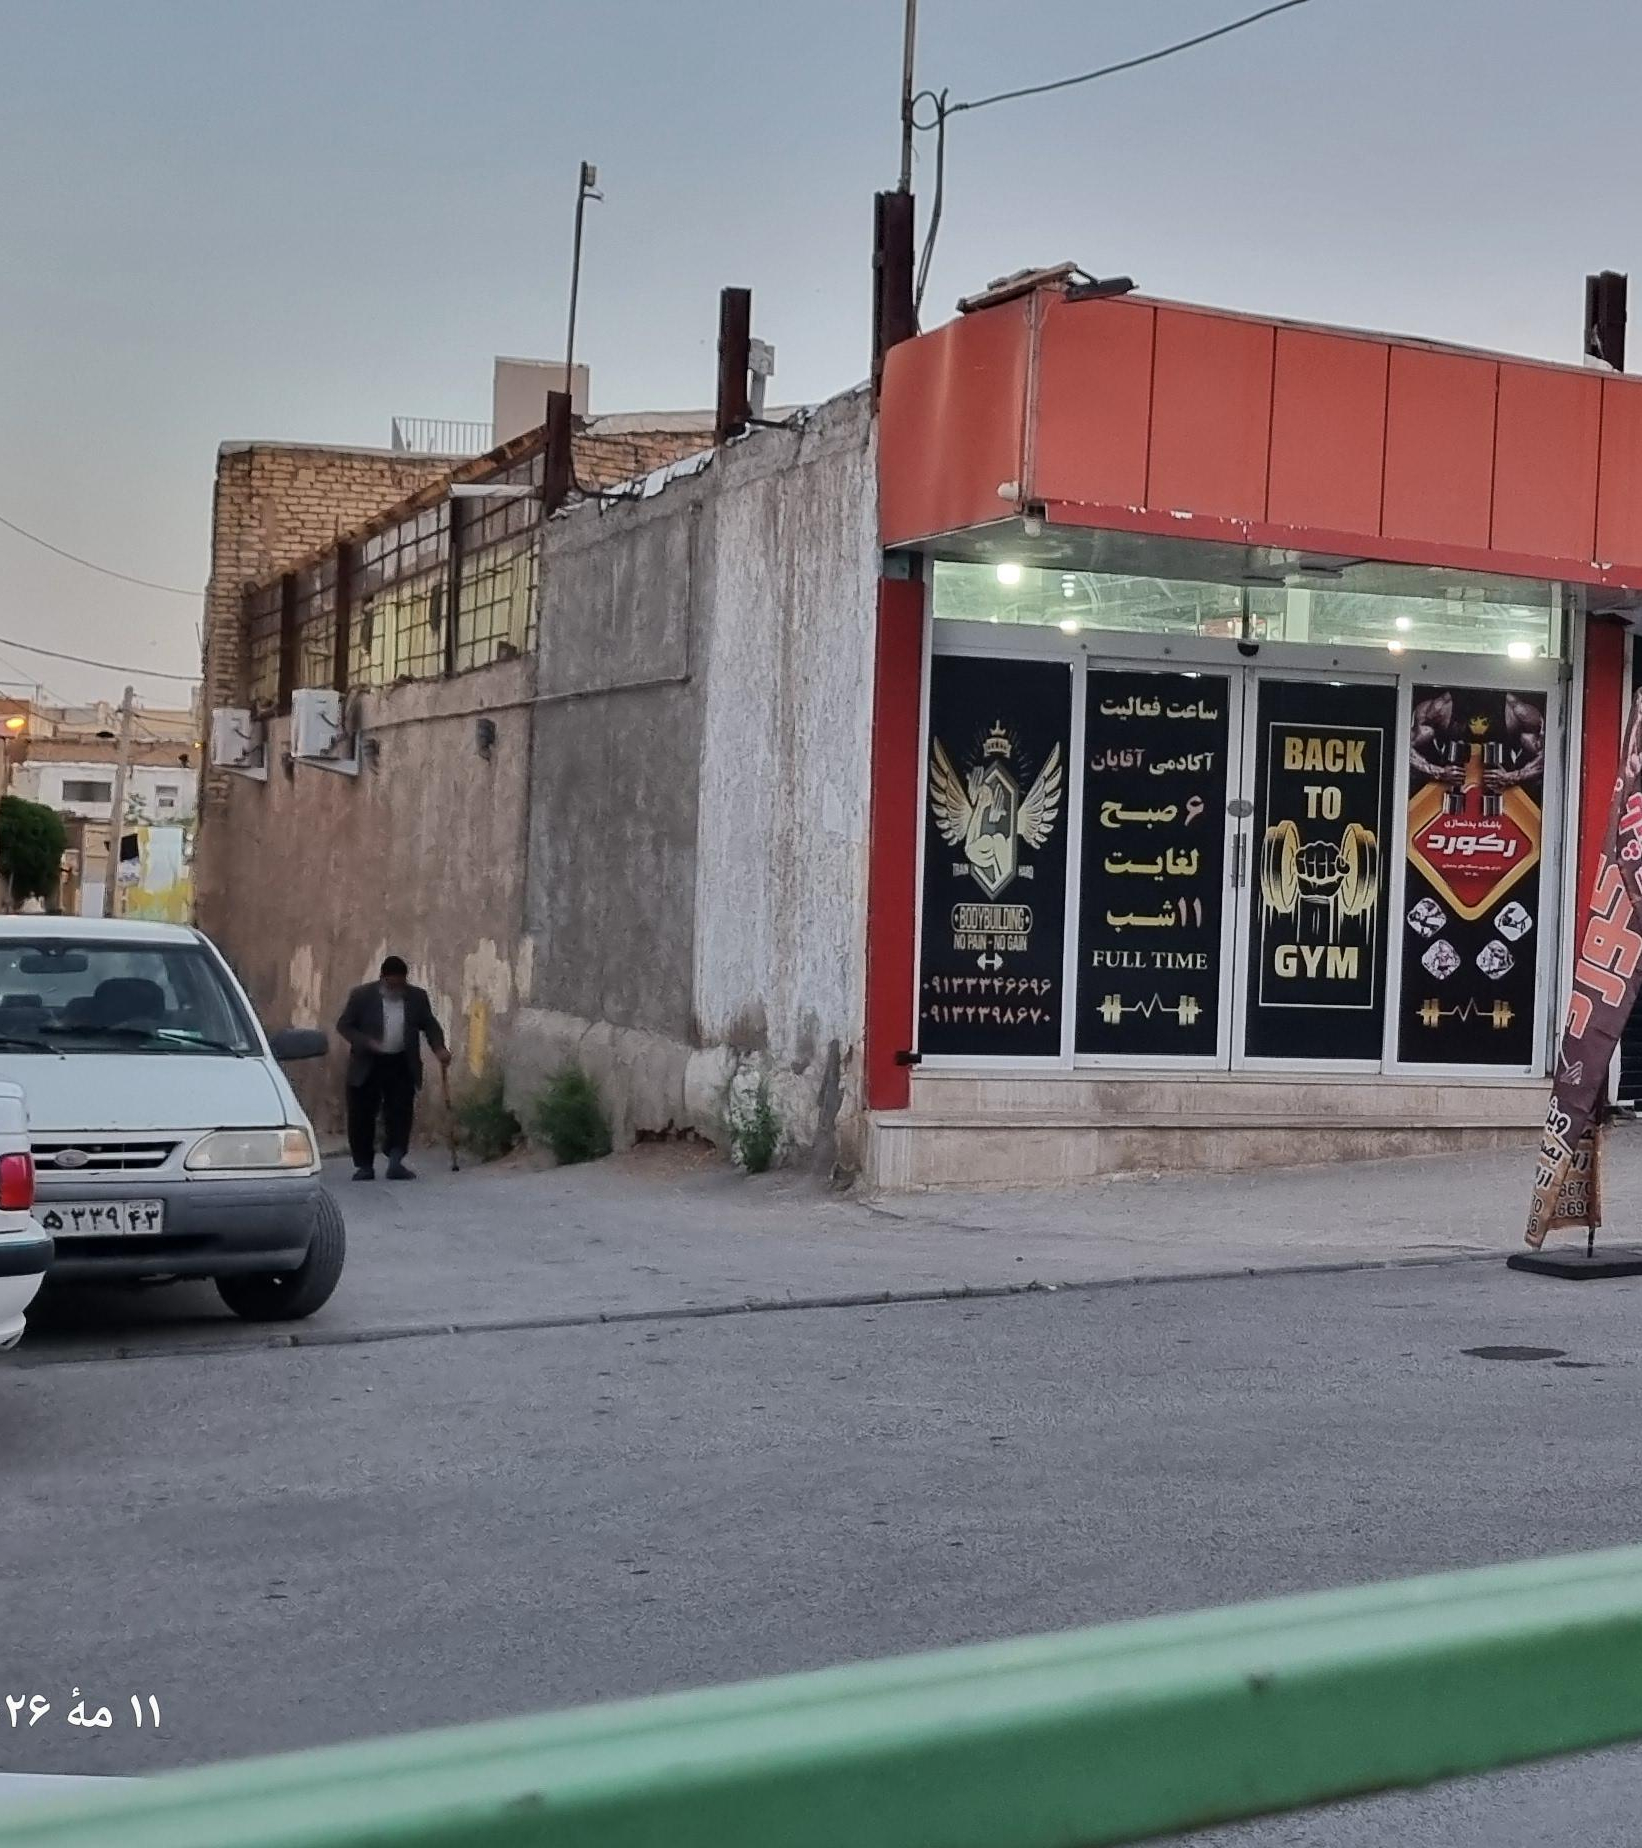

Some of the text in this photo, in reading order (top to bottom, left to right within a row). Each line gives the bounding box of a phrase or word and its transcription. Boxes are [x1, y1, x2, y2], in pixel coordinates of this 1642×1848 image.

[1099, 695, 1219, 721] ساعت فعالیت
[1091, 748, 1215, 776] آکادمی آقایان
[1284, 736, 1366, 774] BACK
[1099, 795, 1205, 829] ۶ صبح
[1304, 785, 1342, 821] TO
[1427, 832, 1517, 858] رکورد
[1103, 847, 1200, 881] لغایت
[959, 906, 1025, 931] BODYBUILDING
[954, 935, 966, 950] NO
[968, 935, 987, 951] PAIN
[994, 935, 1005, 950] NO
[1007, 935, 1028, 951] GAIN
[1092, 950, 1208, 970] FULL TIME
[1274, 944, 1359, 980] GYM
[128, 1210, 159, 1232] ۴۳
